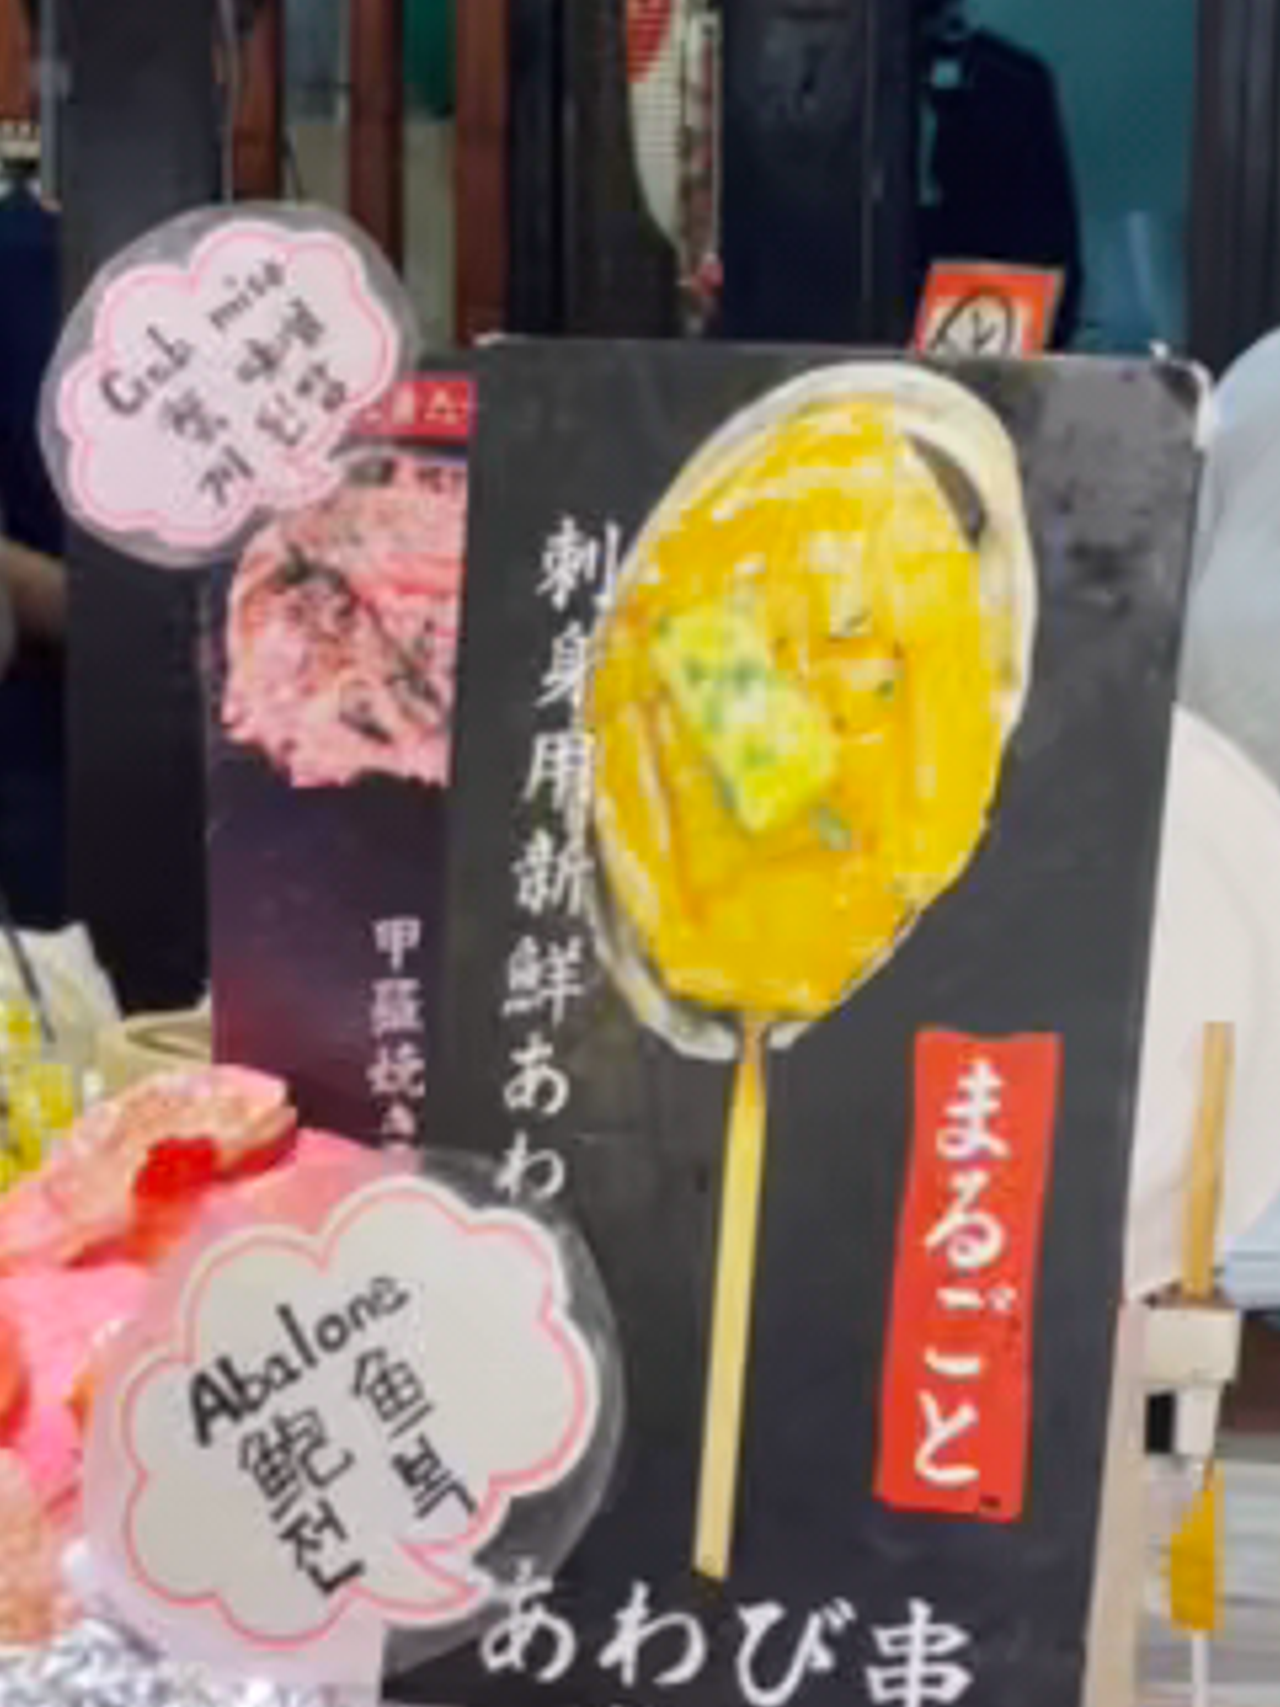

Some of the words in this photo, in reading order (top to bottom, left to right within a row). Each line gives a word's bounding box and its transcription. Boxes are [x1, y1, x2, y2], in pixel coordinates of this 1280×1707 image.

[99, 324, 193, 416] Crab
[915, 1057, 1017, 1487] まるごと
[187, 1274, 411, 1447] Abalone
